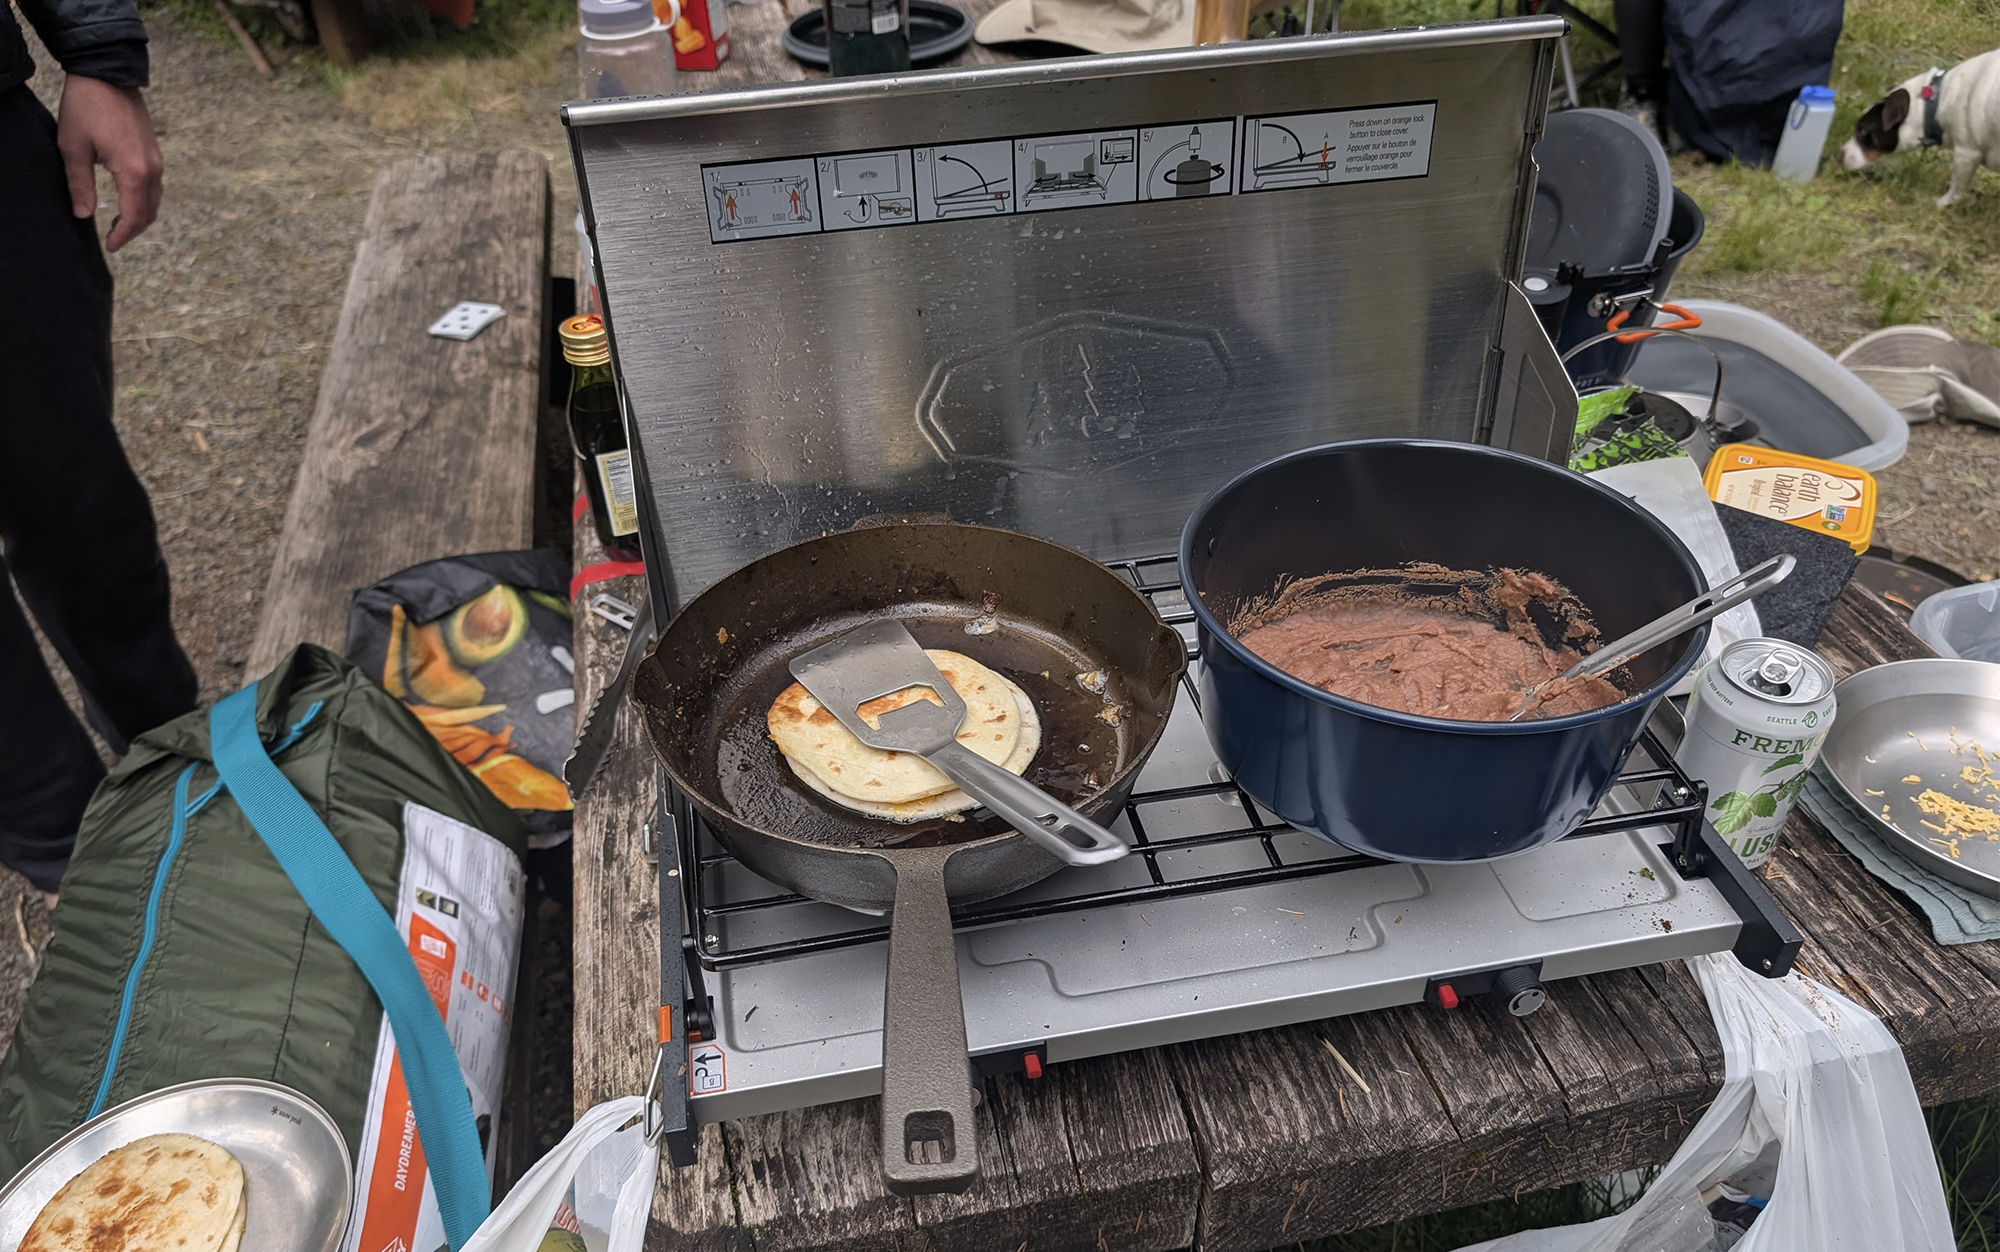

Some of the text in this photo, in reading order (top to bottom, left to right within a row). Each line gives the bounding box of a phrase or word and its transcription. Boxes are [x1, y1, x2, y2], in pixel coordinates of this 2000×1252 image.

[1349, 119, 1365, 128] Press
[1366, 118, 1382, 127] down
[1391, 116, 1412, 126] orange
[1413, 114, 1425, 123] lock
[1143, 131, 1154, 143] 5/
[1323, 132, 1329, 140] A
[1349, 127, 1409, 139] button to close cover.
[1018, 142, 1029, 154] 4/
[1346, 138, 1417, 153] Appuyer sur le bouton de
[916, 151, 928, 163] 3/
[1345, 150, 1413, 163] verrouillage orange pour
[820, 161, 831, 174] 2/
[1344, 164, 1364, 174] fermer
[1365, 164, 1371, 172] le
[1767, 473, 1800, 514] balance
[1797, 472, 1822, 503] earth
[1714, 689, 1734, 706] MATTERS
[1766, 715, 1798, 725] SEATTLE
